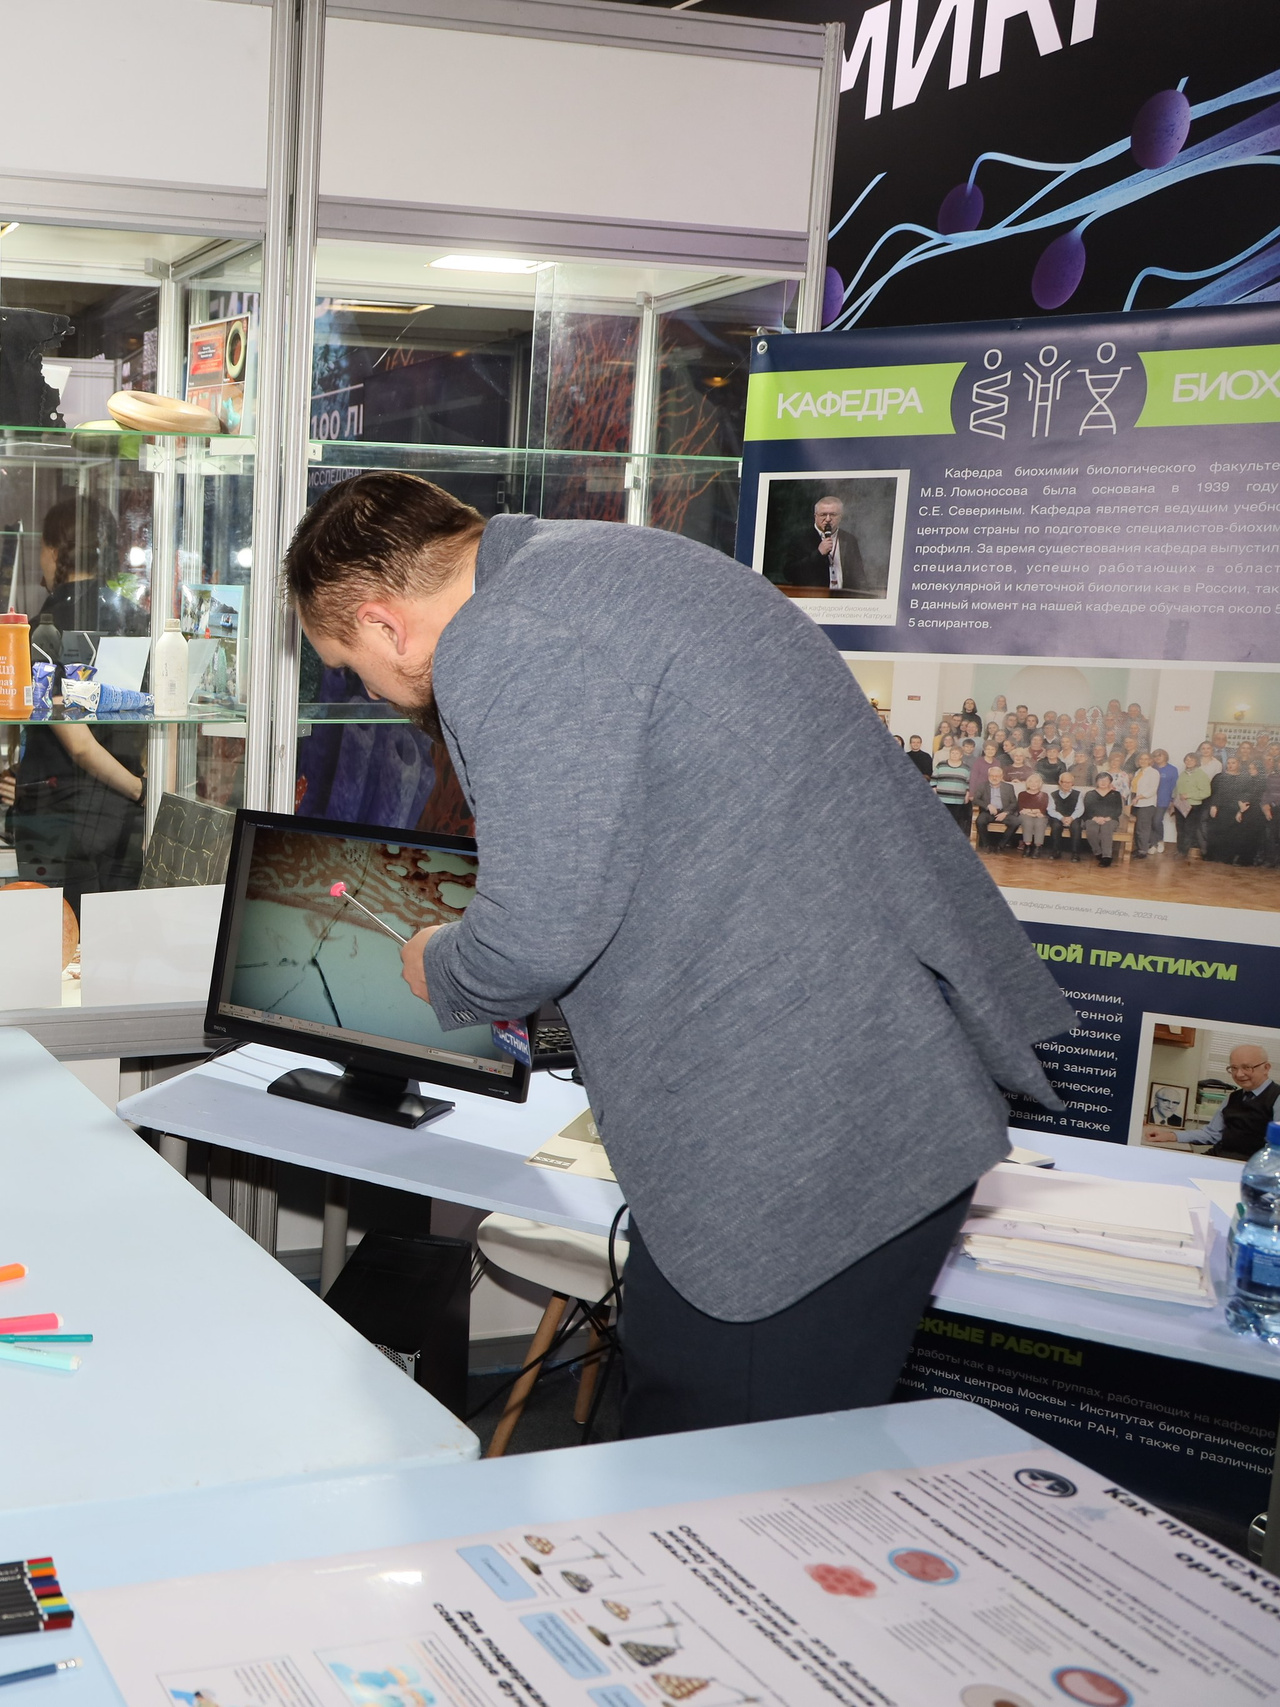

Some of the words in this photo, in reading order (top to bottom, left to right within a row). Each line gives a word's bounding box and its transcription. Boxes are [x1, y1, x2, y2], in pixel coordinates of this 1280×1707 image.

[1172, 369, 1280, 402] БИОХ
[777, 387, 923, 421] КАФЕДРА
[945, 468, 1002, 479] Кафедра
[1015, 466, 1079, 476] биохимии
[1086, 464, 1196, 475] биологического
[921, 488, 947, 497] М.В.
[950, 487, 1028, 497] Ломоносова
[1043, 486, 1077, 495] была
[1092, 484, 1155, 494] основана
[1198, 482, 1230, 492] 1939
[1246, 482, 1278, 493] году
[919, 506, 943, 516] С.Е.
[948, 506, 1025, 517] Севериным.
[1030, 504, 1091, 516] Кафедра
[1096, 505, 1159, 514] является
[1164, 503, 1228, 515] ведущим
[917, 526, 968, 536] центром
[973, 526, 1019, 536] страны
[1025, 526, 1040, 534] по
[1044, 525, 1121, 536] подготовке
[915, 544, 973, 555] профиля.
[977, 543, 993, 553] За
[996, 545, 1035, 554] время
[1038, 544, 1141, 555] существования
[1145, 543, 1207, 555] кафедра
[913, 564, 1017, 574] специалистов,
[1027, 564, 1090, 575] успешно
[1098, 563, 1196, 575] работающих
[912, 582, 1000, 593] молекулярной
[1016, 582, 1084, 592] клеточной
[1088, 582, 1151, 592] биологии
[1155, 584, 1179, 592] как
[1195, 583, 1250, 594] России,
[1255, 585, 1279, 593] так
[910, 600, 918, 609] В
[921, 600, 968, 610] данный
[971, 602, 1018, 610] момент
[1022, 602, 1036, 610] на
[1040, 602, 1082, 611] нашей
[1086, 602, 1145, 614] кафедре
[1150, 603, 1224, 615] обучаются
[1228, 605, 1271, 614] около
[908, 618, 915, 627] 5
[918, 620, 992, 629] аспирантов.
[1090, 949, 1237, 981] ПРАКТИКУМ
[1075, 1010, 1123, 1023] генной
[1064, 1063, 1117, 1078] занятий
[1060, 1117, 1067, 1125] а
[1070, 1118, 1110, 1132] также
[990, 1332, 1082, 1366] РАБОТЫ
[912, 1363, 960, 1381] научных
[964, 1375, 1013, 1395] центров
[1018, 1387, 1067, 1407] Москвы
[1080, 1402, 1154, 1428] Институтах
[917, 1348, 960, 1364] работы
[963, 1358, 984, 1370] как
[988, 1364, 994, 1372] в
[998, 1368, 1048, 1385] научных
[1052, 1379, 1104, 1399] группах,
[1108, 1393, 1190, 1419] работающих
[1194, 1413, 1210, 1423] на
[1214, 1417, 1276, 1439] кафедре
[933, 1385, 1019, 1412] молекулярной
[1025, 1408, 1081, 1428] генетики
[1088, 1422, 1118, 1438] РАН,
[1125, 1433, 1133, 1441] а
[1139, 1435, 1180, 1452] также
[1103, 1487, 1156, 1517] Как
[1158, 1518, 1280, 1598] происхо
